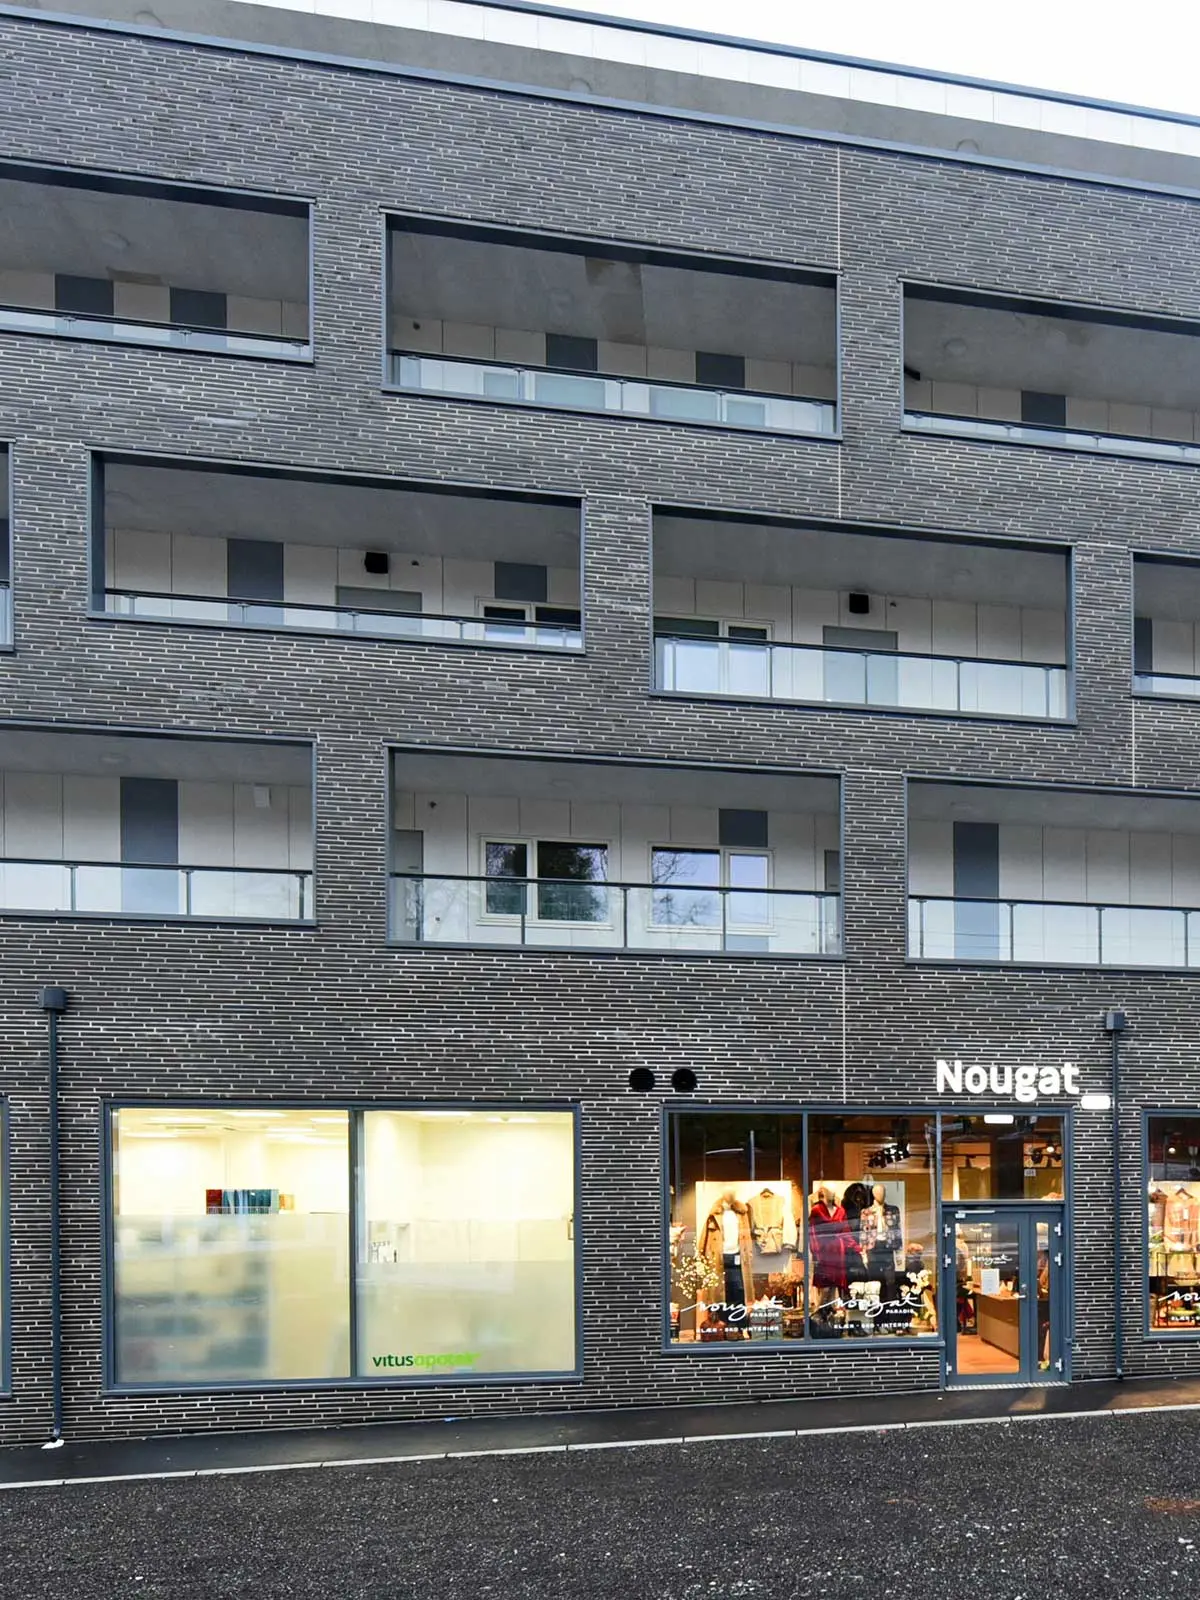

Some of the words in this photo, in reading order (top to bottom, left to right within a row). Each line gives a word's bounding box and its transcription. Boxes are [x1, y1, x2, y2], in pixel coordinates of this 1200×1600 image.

[936, 1060, 1080, 1102] Nougat
[681, 1296, 794, 1321] nougat
[818, 1293, 928, 1317] nougat
